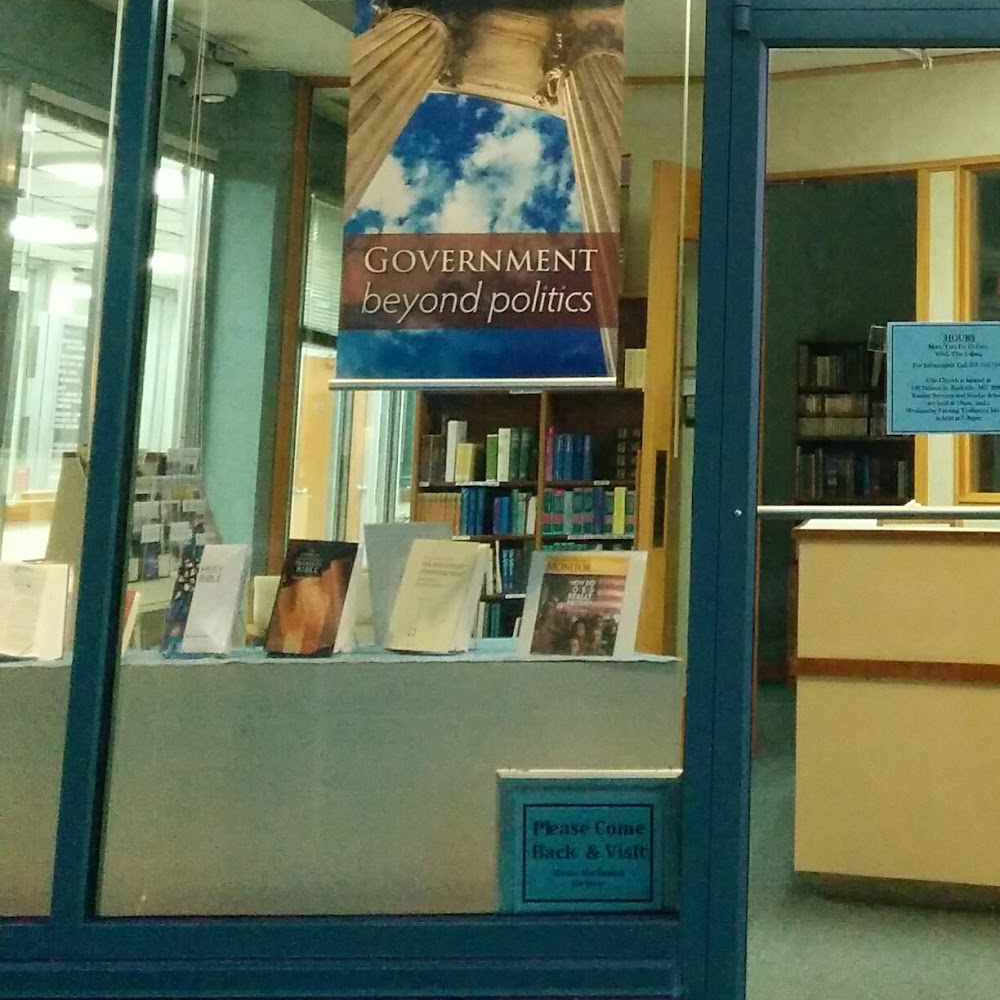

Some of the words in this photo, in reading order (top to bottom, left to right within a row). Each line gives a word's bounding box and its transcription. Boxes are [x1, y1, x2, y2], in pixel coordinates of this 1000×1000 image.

[364, 246, 599, 274] GOVERNMENT
[360, 280, 483, 324] beyond
[486, 280, 593, 324] politics
[944, 334, 976, 342] HOURS
[533, 820, 590, 836] Please
[594, 820, 645, 836] Come
[532, 843, 576, 860] Back
[585, 844, 599, 860] &
[604, 843, 647, 860] Visit
